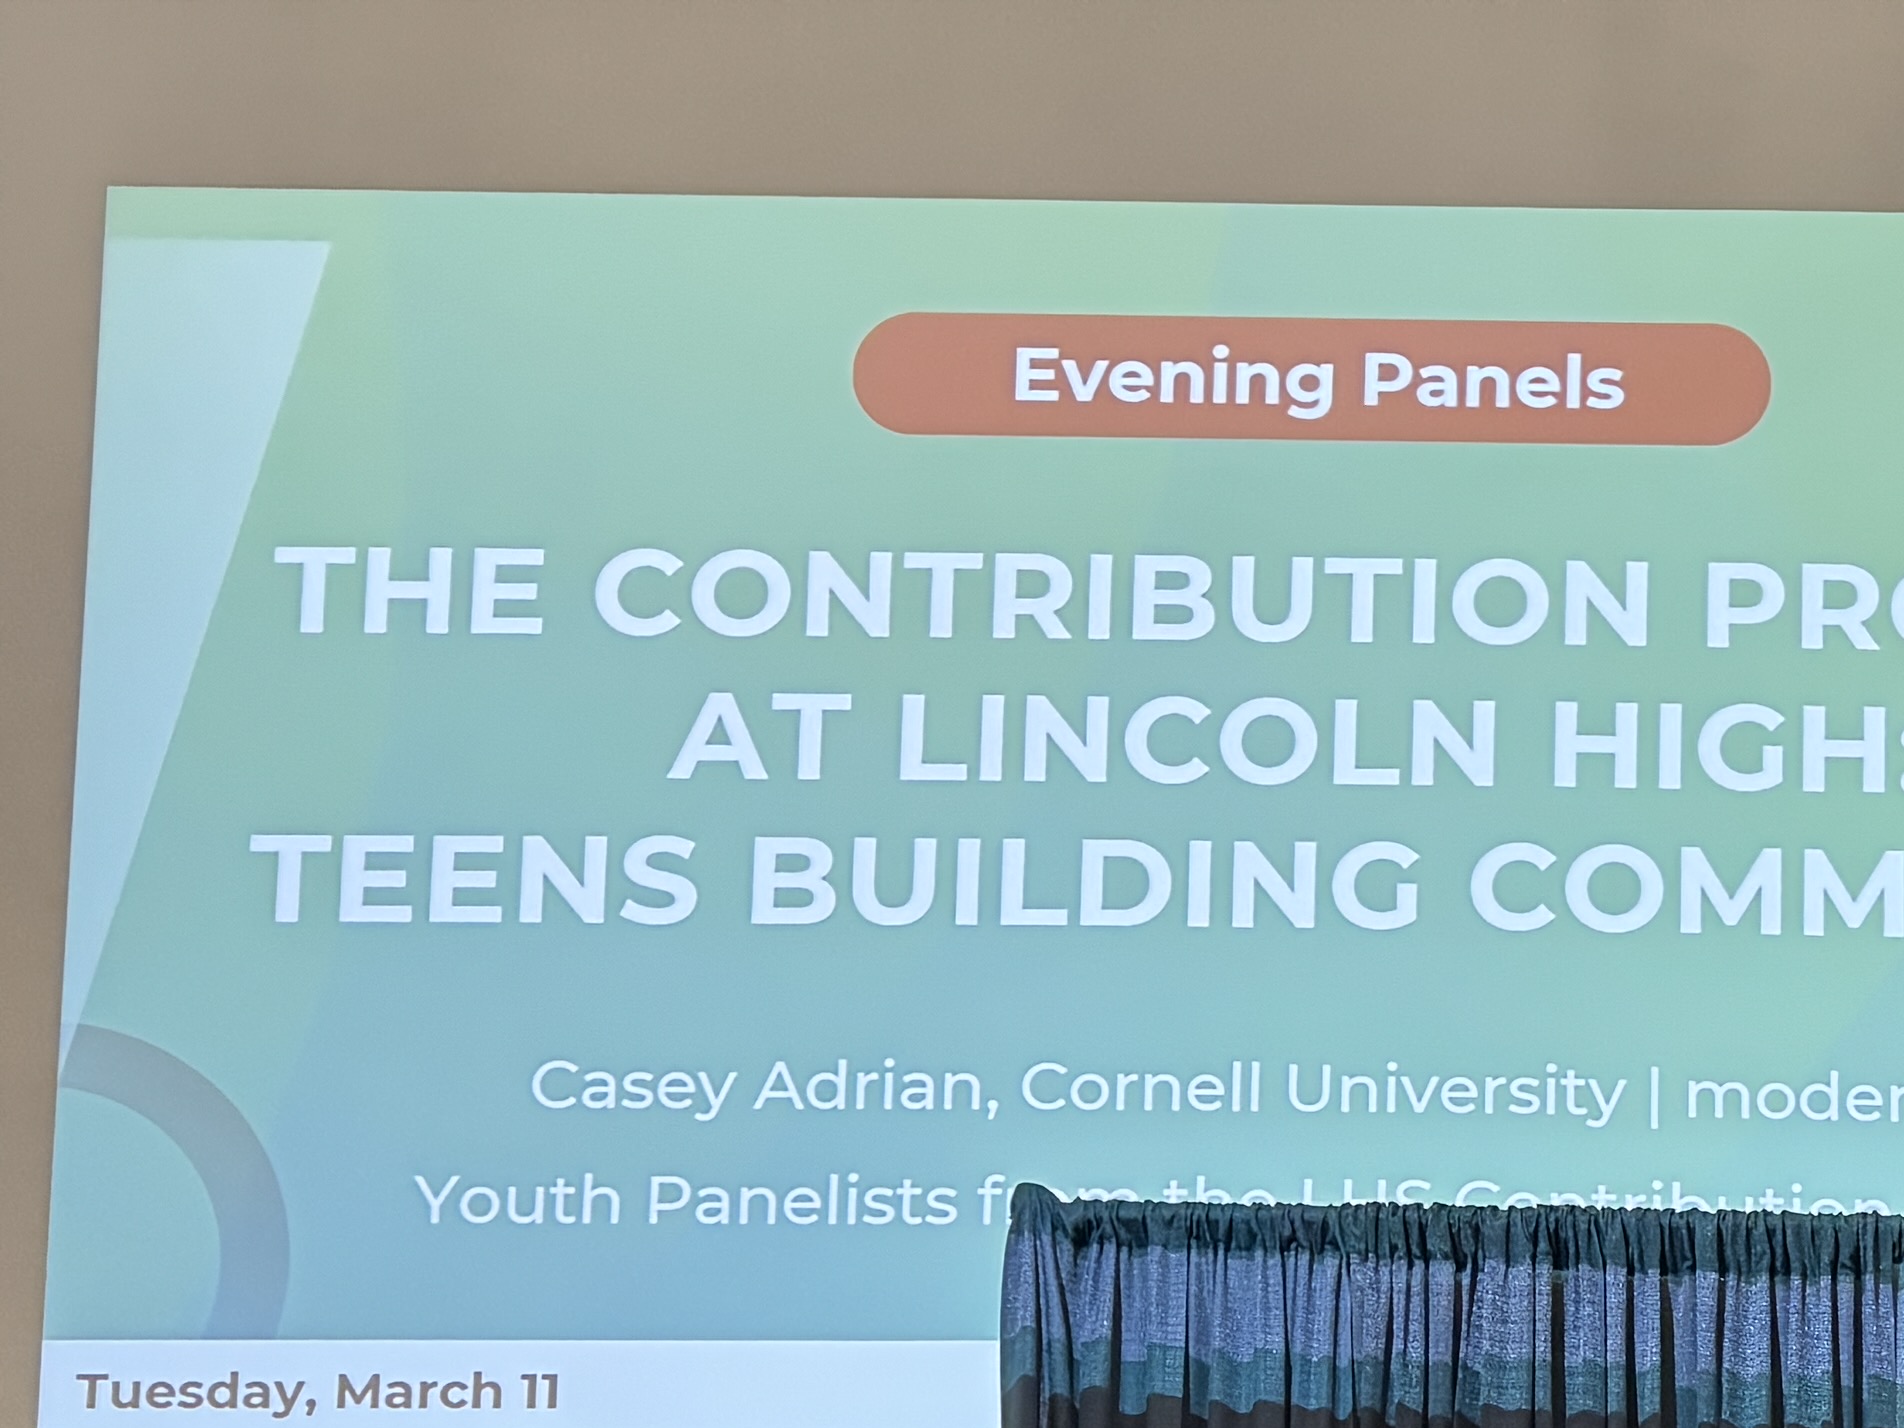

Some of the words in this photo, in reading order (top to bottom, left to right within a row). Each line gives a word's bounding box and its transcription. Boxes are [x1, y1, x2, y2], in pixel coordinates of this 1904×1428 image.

[1015, 345, 1333, 419] Evening
[1364, 353, 1624, 408] Panels
[275, 547, 544, 634] THE
[596, 549, 1648, 646] CONTRIBUTION
[667, 693, 851, 779] AT
[900, 695, 1495, 786] LINCOLN
[250, 835, 697, 924] TEENS
[751, 837, 1420, 929] BUILDING
[533, 1061, 737, 1120] Casey
[753, 1058, 998, 1119] Adrian,
[1023, 1061, 1260, 1111] Cornell
[1289, 1062, 1626, 1127] University
[415, 1173, 619, 1224] Youth
[649, 1173, 957, 1224] Panelists
[76, 1371, 316, 1418] Tuesday,
[337, 1371, 501, 1408] March
[521, 1374, 557, 1408] 11
